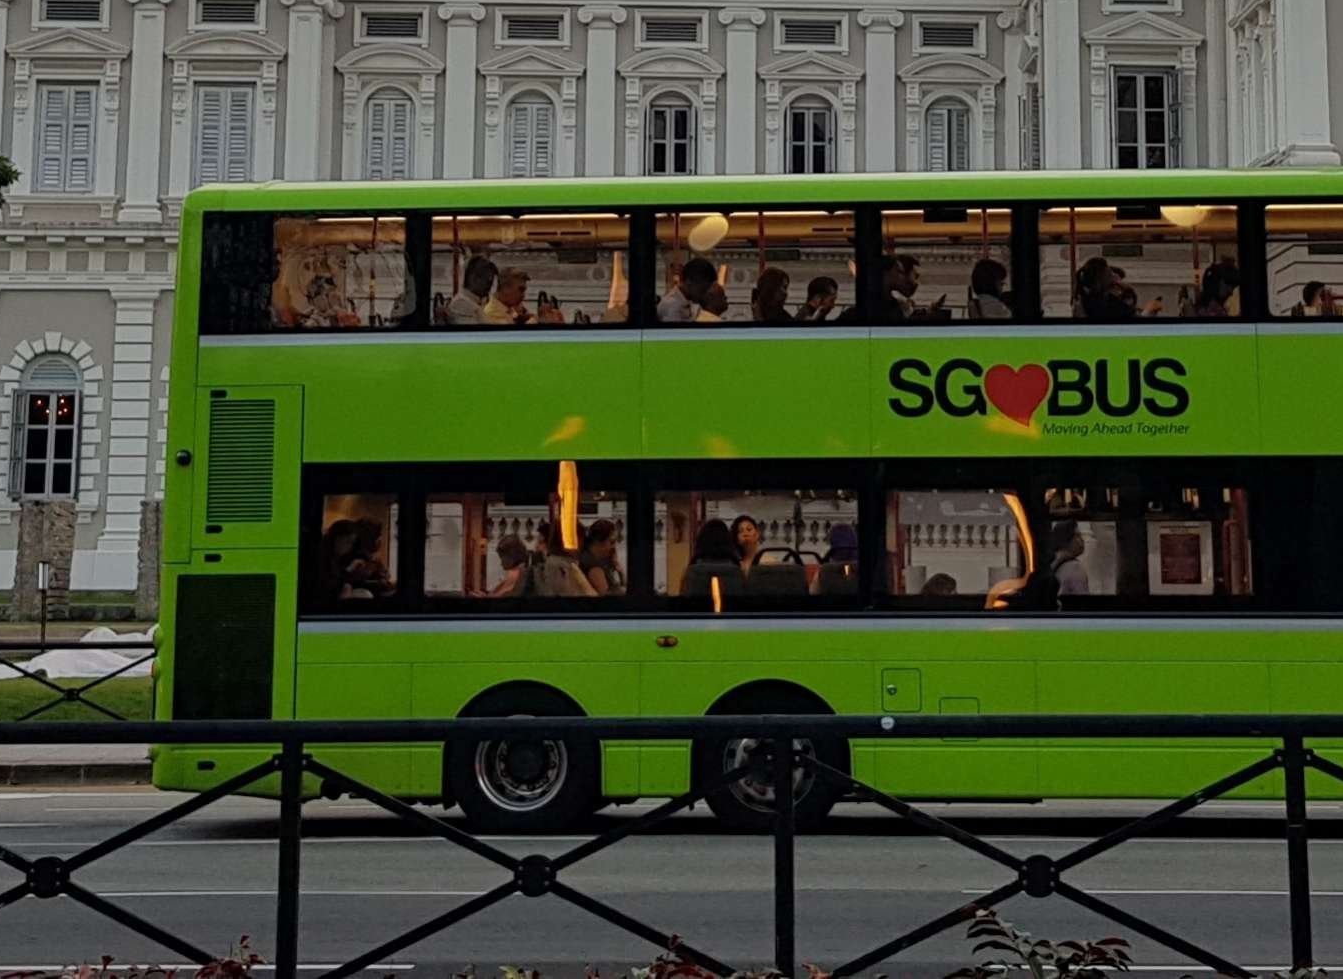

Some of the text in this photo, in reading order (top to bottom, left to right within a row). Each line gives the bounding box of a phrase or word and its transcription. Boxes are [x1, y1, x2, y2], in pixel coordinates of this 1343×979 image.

[889, 358, 1190, 417] SG BUS
[1043, 422, 1191, 437] Moving Ahead Together
